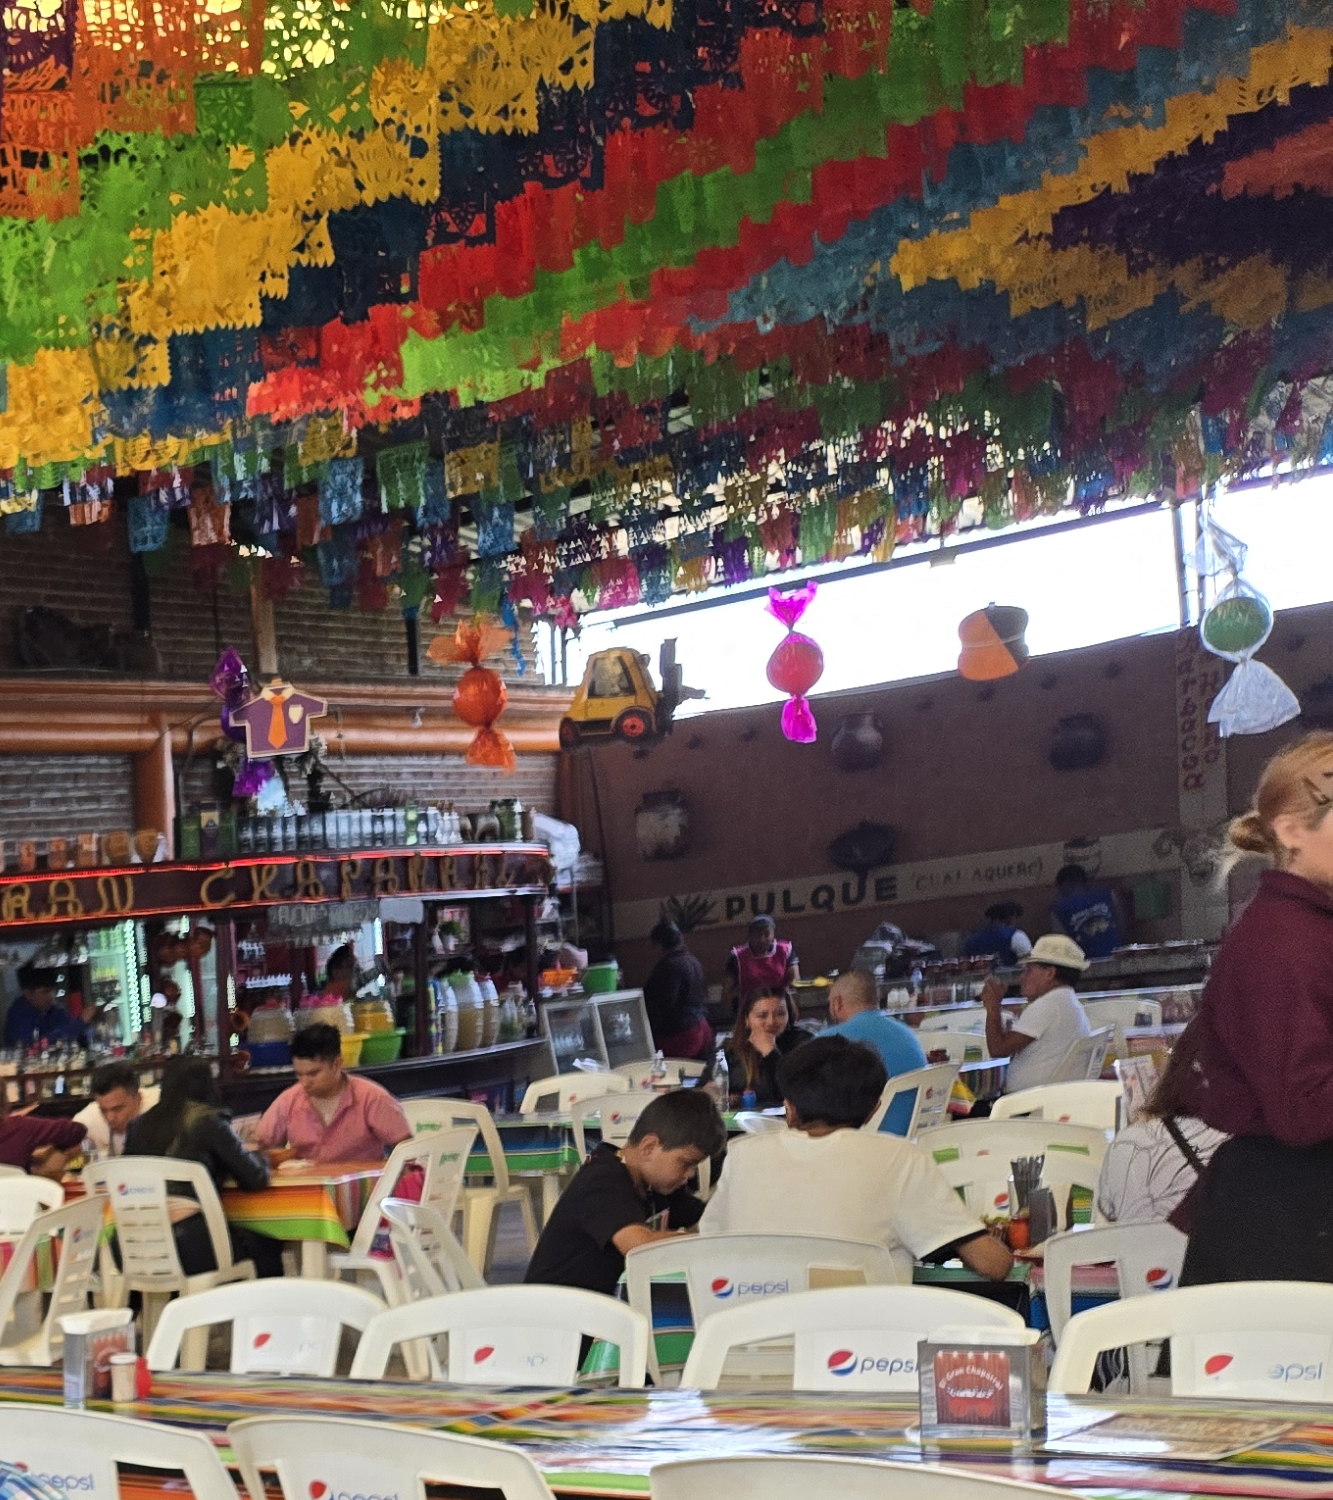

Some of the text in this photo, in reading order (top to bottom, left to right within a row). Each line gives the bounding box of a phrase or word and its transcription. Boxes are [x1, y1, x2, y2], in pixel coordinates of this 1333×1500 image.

[726, 875, 899, 919] PULQUE
[738, 1278, 789, 1297] pepsi
[1268, 1362, 1323, 1383] epsi
